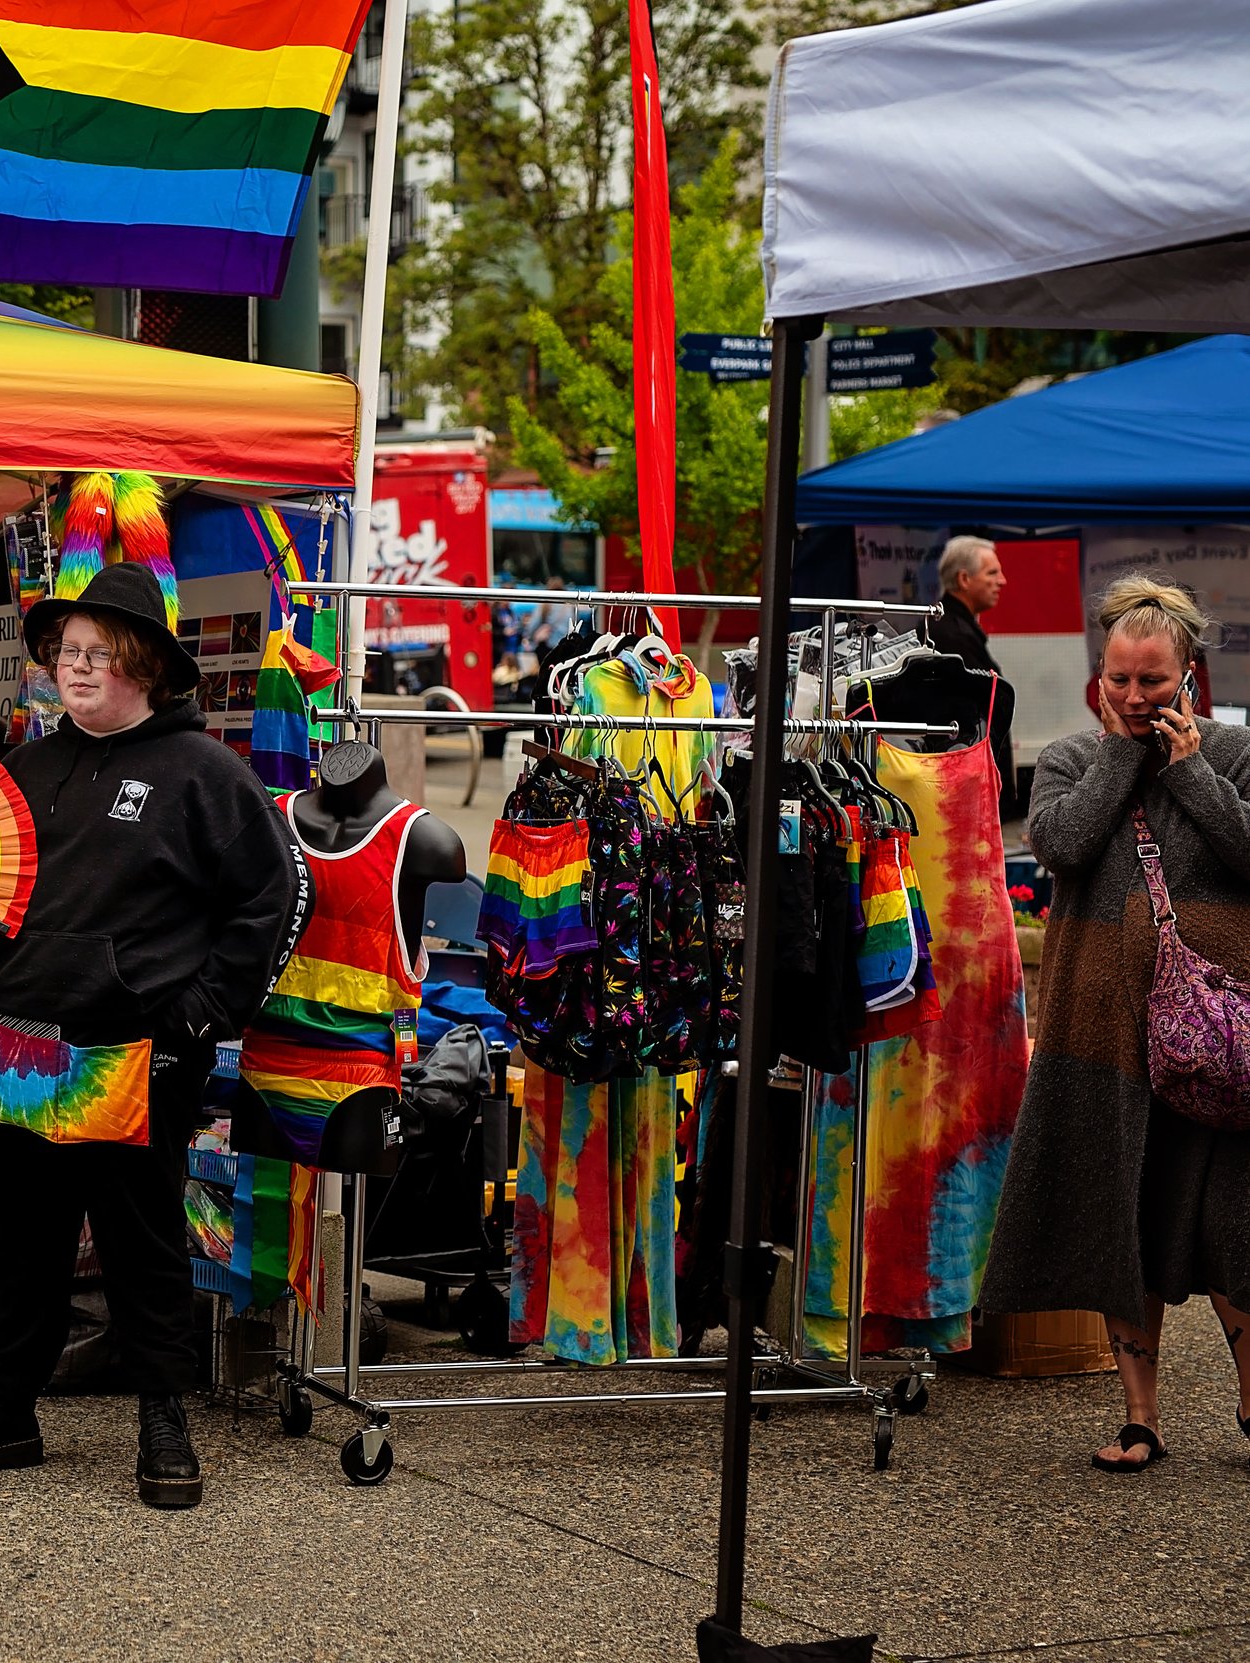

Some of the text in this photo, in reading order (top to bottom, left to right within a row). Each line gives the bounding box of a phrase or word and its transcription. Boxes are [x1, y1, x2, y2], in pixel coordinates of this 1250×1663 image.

[721, 338, 758, 351] PUBLIC
[832, 353, 915, 370] POLICE DEPARTMENT
[278, 844, 308, 966] MEMENTO
